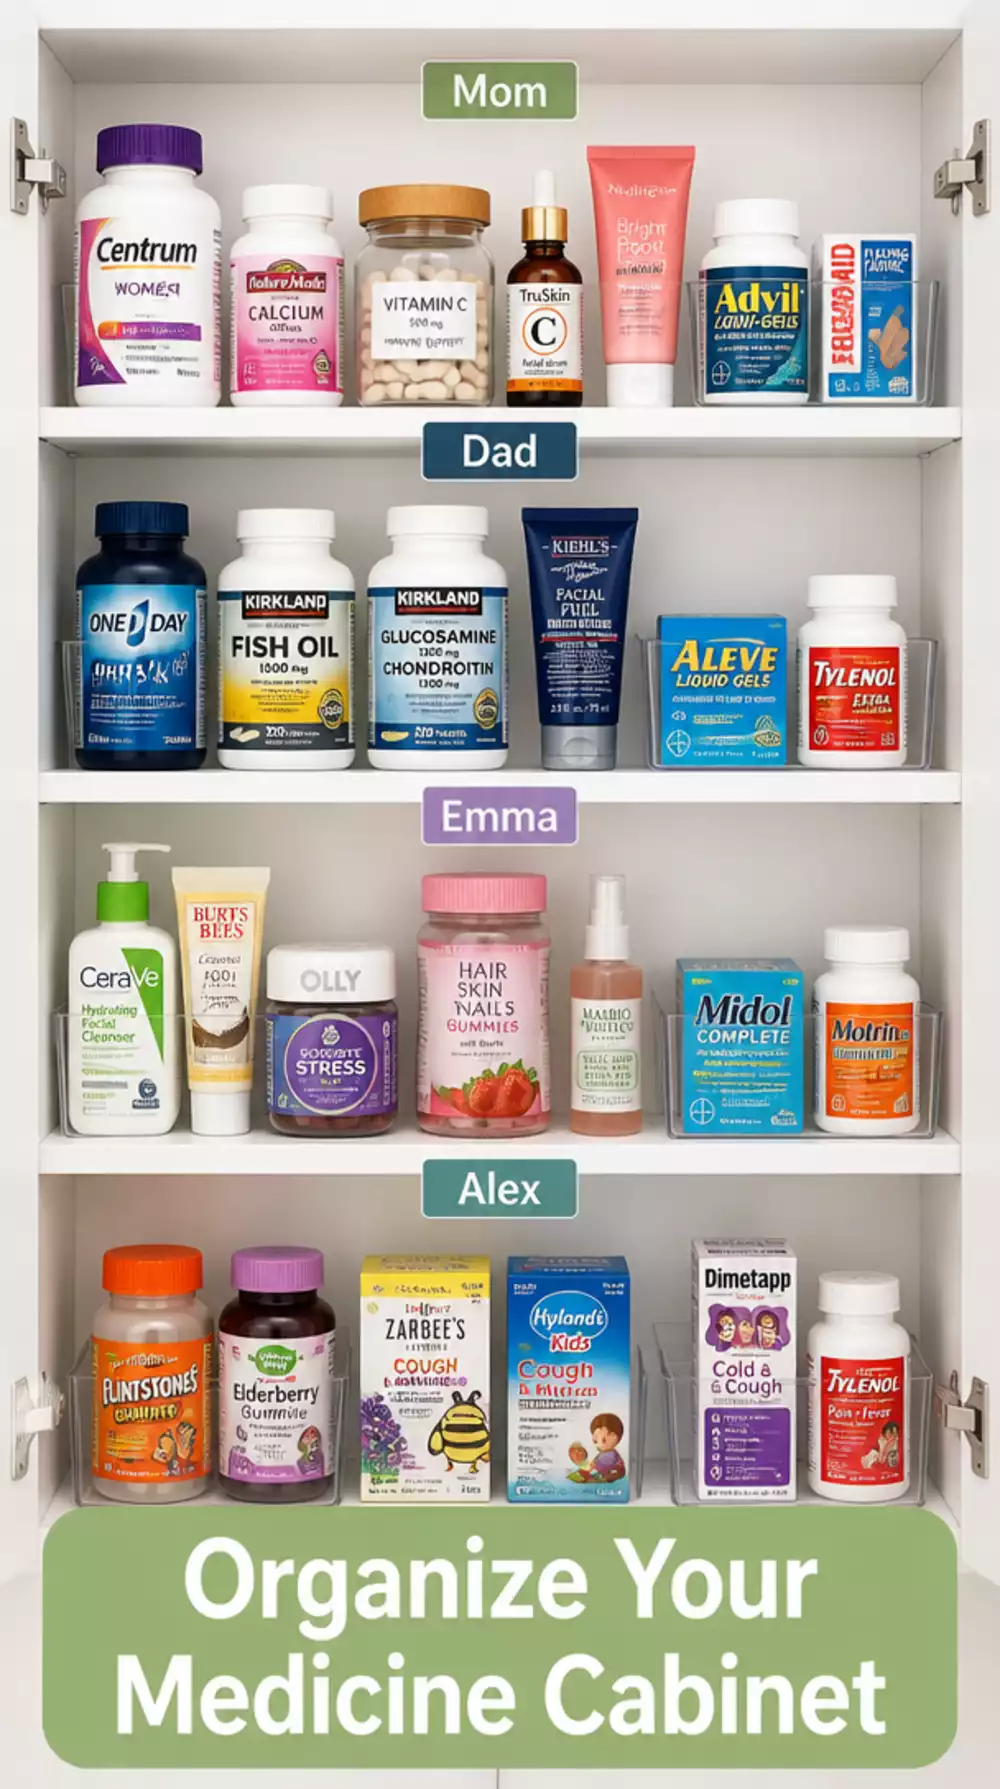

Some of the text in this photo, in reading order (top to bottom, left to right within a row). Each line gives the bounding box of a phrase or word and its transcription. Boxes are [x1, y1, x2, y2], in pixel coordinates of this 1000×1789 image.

[97, 237, 197, 263] Centrum
[519, 288, 570, 302] TruSkin
[714, 282, 799, 314] Advil
[383, 296, 468, 312] VITAMIN C
[248, 305, 324, 321] CALCIUM
[531, 316, 556, 346] C
[553, 540, 610, 553] KIEHL'S
[245, 594, 327, 610] KIRKLAND
[397, 591, 480, 606] KIRKLAND
[556, 588, 605, 601] FACIAL
[90, 613, 188, 632] ONE DAY
[381, 629, 497, 644] GLUCOSAMINE
[232, 635, 339, 659] FISH OIL
[260, 662, 289, 674] 1000
[383, 661, 494, 676] CHONDROITIN
[813, 661, 896, 687] TYLENOL
[733, 674, 771, 688] GELS
[200, 922, 245, 939] BEES
[80, 965, 159, 989] CeraVe
[459, 961, 507, 980] HAIR
[300, 969, 361, 992] OLLY
[457, 981, 502, 998] SKIN
[82, 1004, 138, 1019] Hydrating
[693, 993, 793, 1028] Midol
[82, 1017, 116, 1029] Facial
[446, 1018, 519, 1034] GUMMIES
[831, 1018, 900, 1042] Motrin
[82, 1030, 136, 1043] Cleanser
[696, 1029, 791, 1044] COMPLETE
[296, 1060, 366, 1076] STRESS
[705, 1267, 791, 1293] Dimetapp
[385, 1317, 466, 1341] ZARBEE'S
[549, 1331, 592, 1353] Kids
[393, 1357, 458, 1375] COUGH
[518, 1359, 593, 1384] Cough
[713, 1360, 755, 1378] Cold
[233, 1381, 320, 1405] Elderberry
[725, 1378, 782, 1398] Cough
